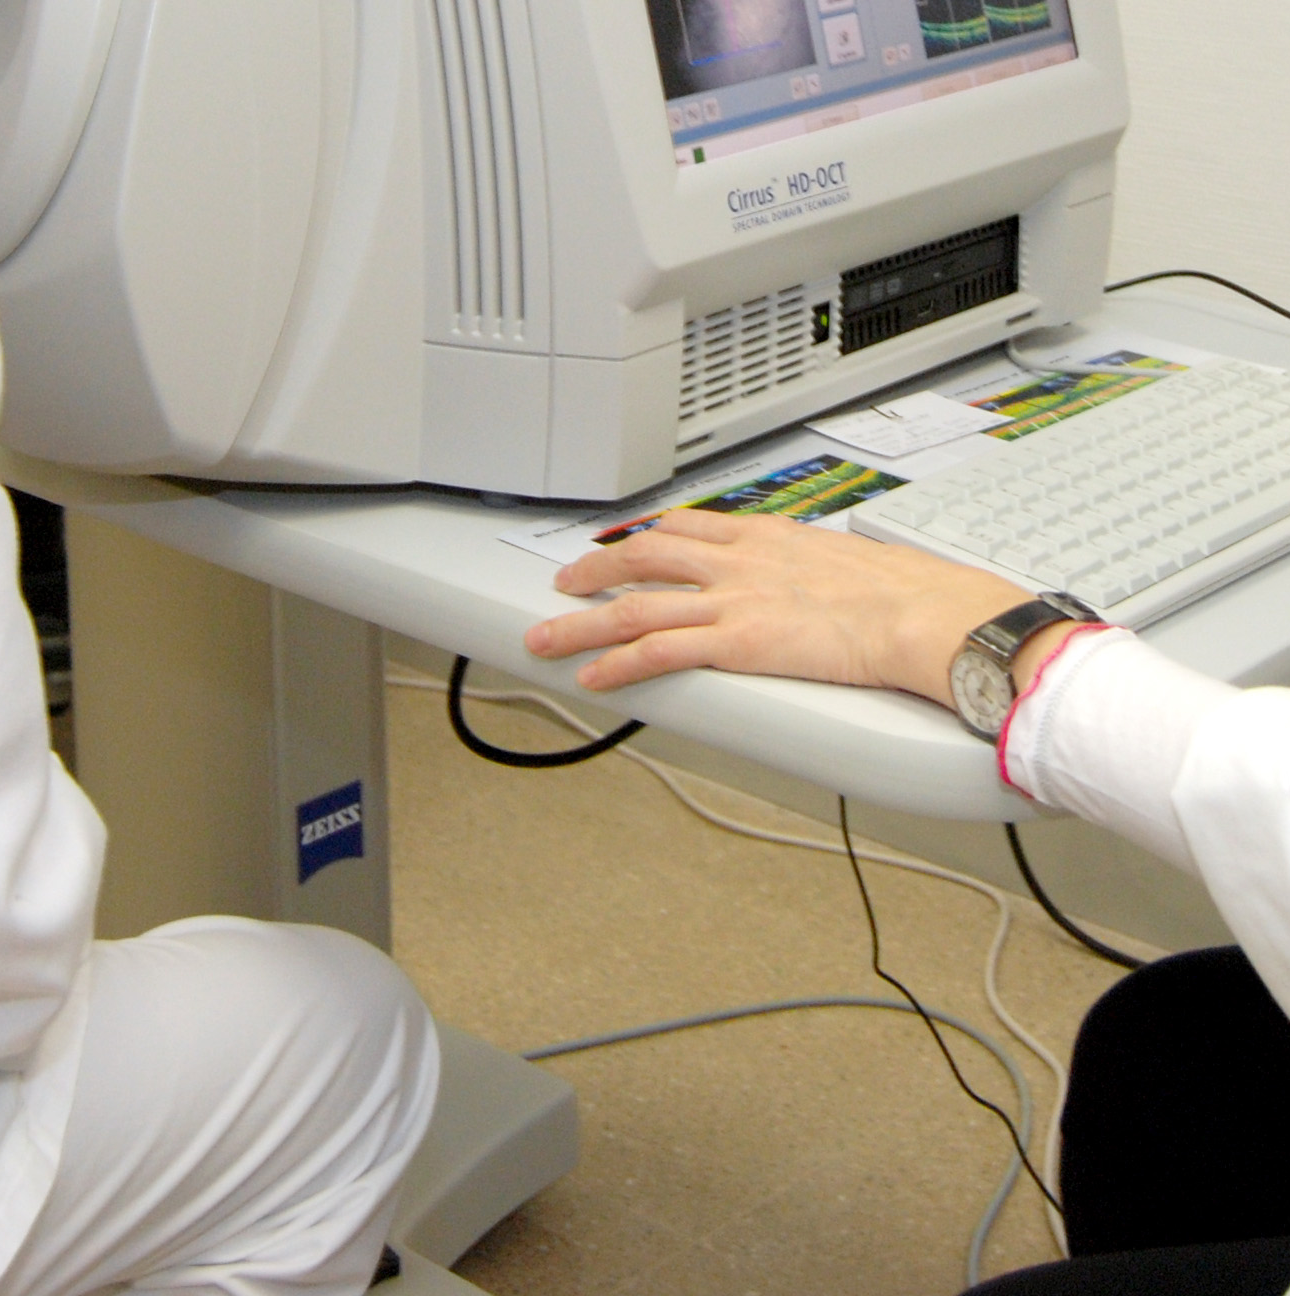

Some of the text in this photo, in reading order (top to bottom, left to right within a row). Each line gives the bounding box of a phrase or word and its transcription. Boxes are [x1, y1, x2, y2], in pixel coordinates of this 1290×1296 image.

[786, 161, 847, 197] HD-OCT
[732, 191, 852, 234] SPECTRAL DOMAIN TECHNOLOGY
[301, 803, 361, 846] ZEISS
